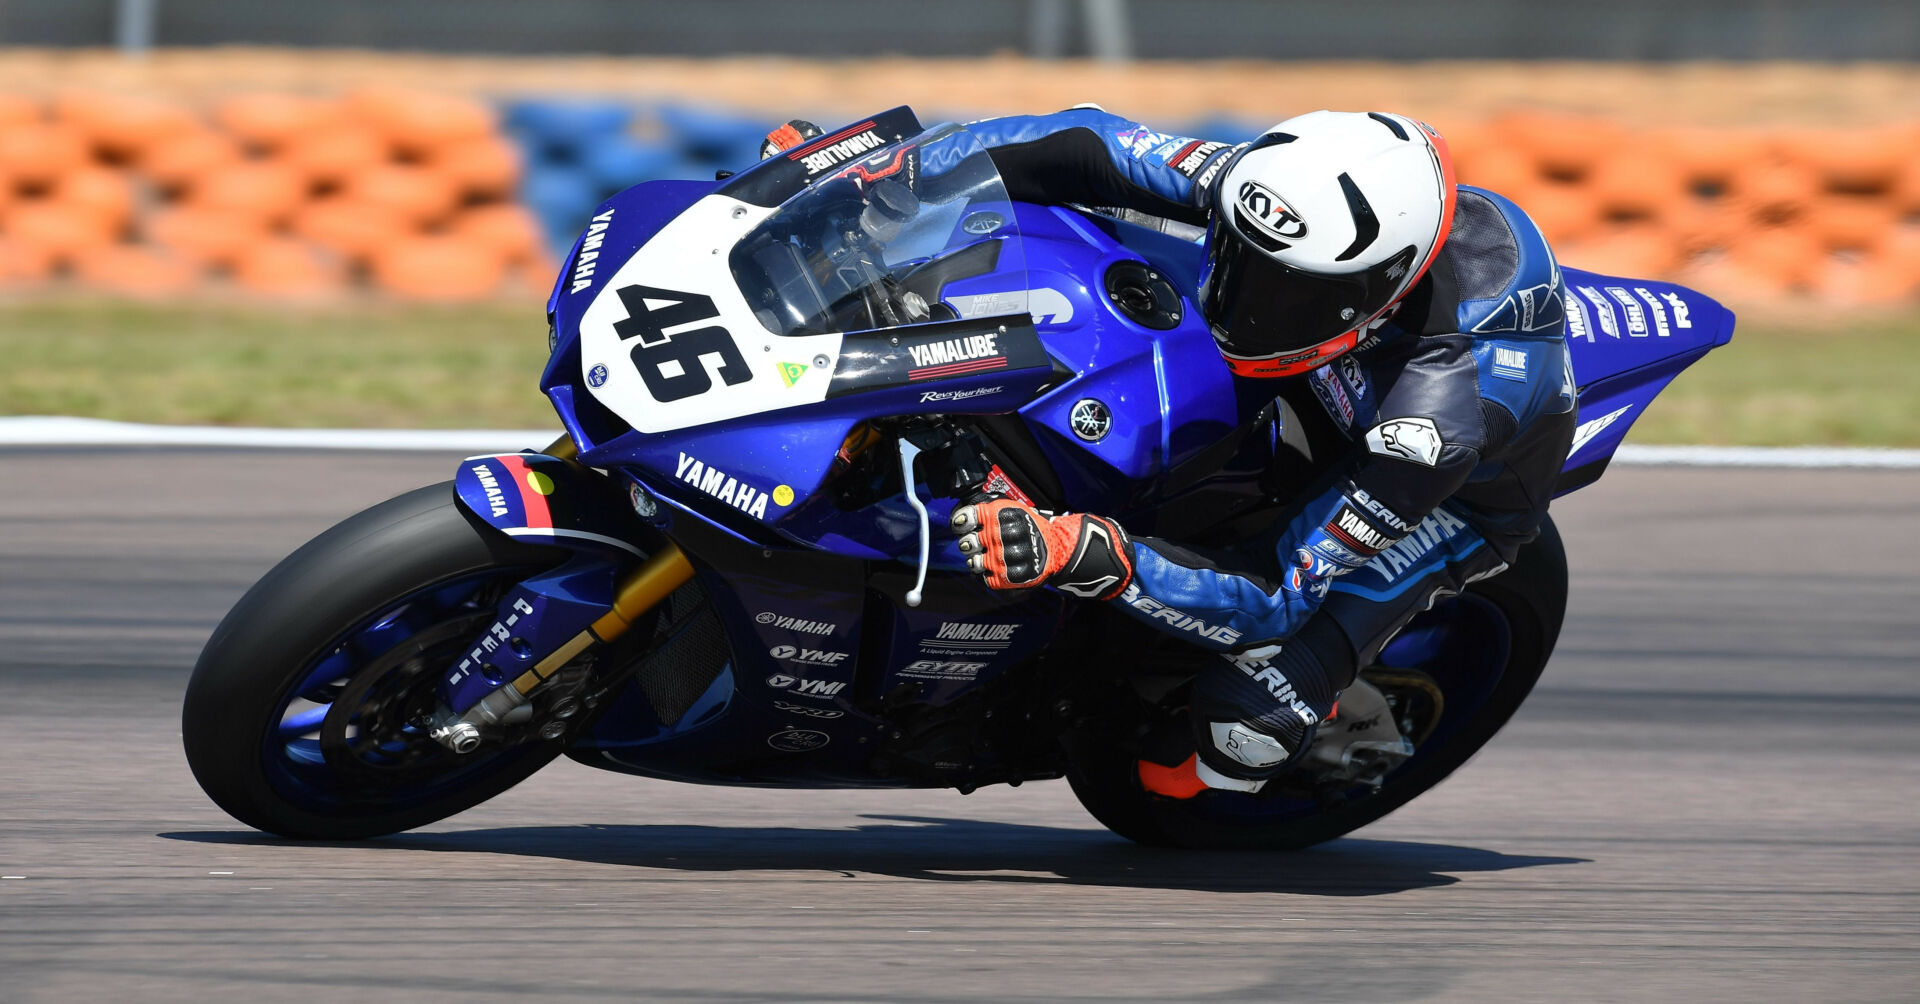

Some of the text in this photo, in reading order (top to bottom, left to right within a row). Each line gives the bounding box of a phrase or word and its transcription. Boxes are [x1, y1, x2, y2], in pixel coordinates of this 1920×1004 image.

[801, 131, 886, 175] YAMALUBE
[1241, 184, 1301, 231] KYT
[571, 209, 615, 294] YAMAHA
[1659, 292, 1692, 328] RK
[612, 283, 753, 403] 46
[908, 333, 998, 367] YAMALUBE
[1496, 347, 1527, 369] YAMALUBE
[472, 464, 508, 518] YAMAHA
[675, 452, 769, 520] YAMAHA
[1353, 489, 1421, 532] BERIN
[774, 615, 836, 636] YAMAHA
[936, 622, 1020, 641] YAMALUBE
[1120, 583, 1243, 645] BERING
[450, 598, 533, 685] PIRELLI
[799, 648, 849, 663] YMF
[797, 679, 848, 695] YMI
[902, 660, 990, 674] GYTR
[1232, 655, 1319, 726] ERING
